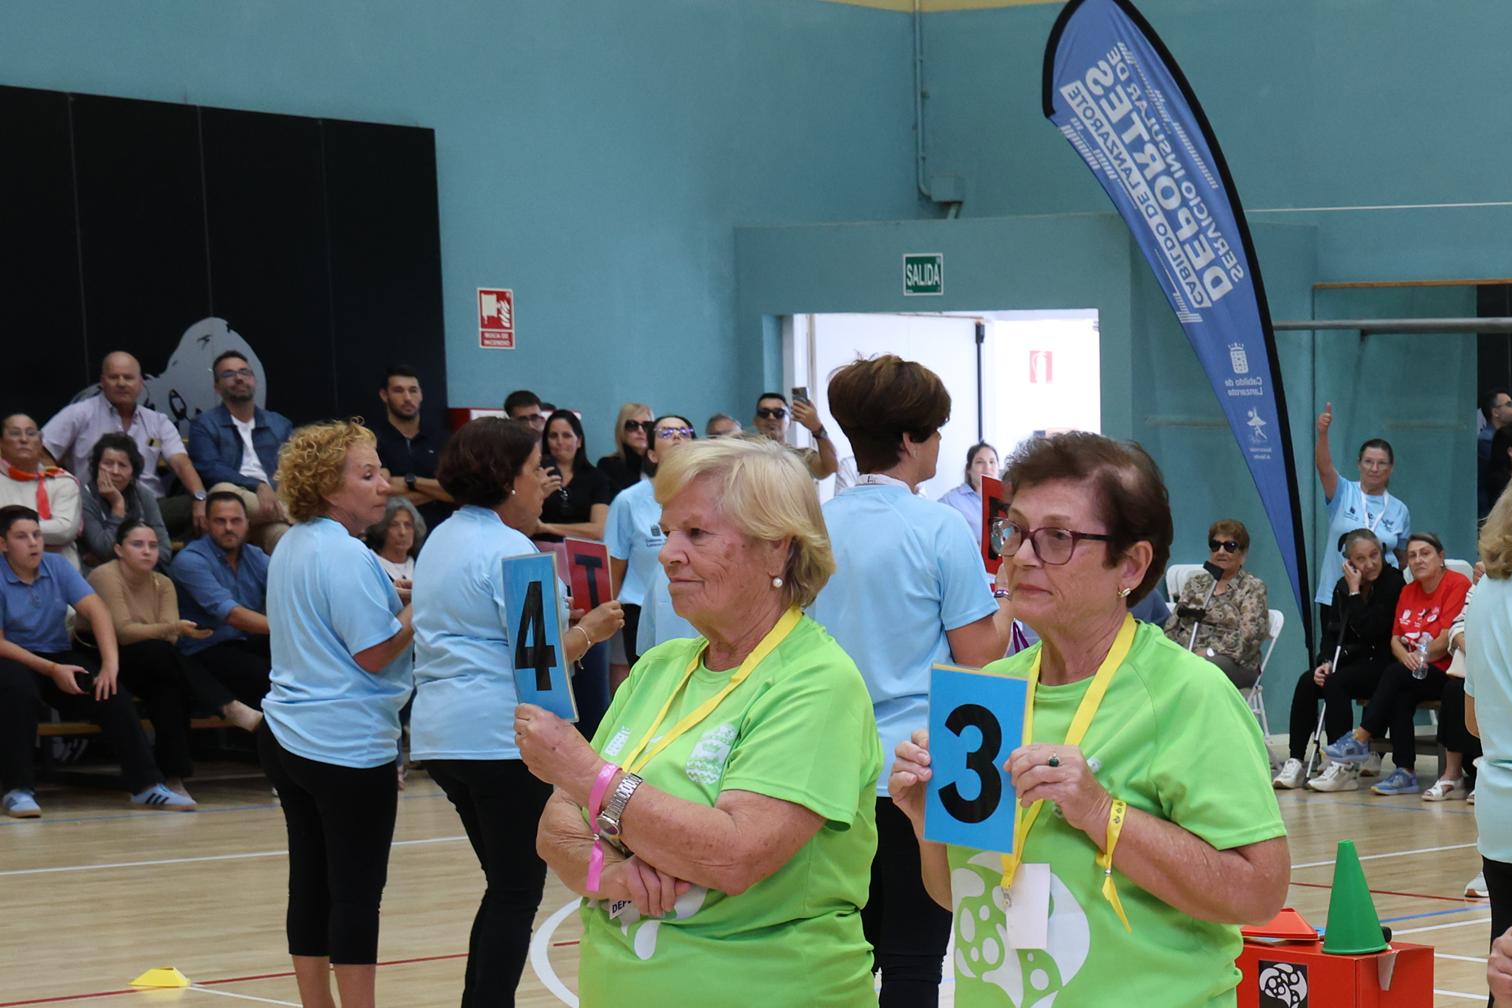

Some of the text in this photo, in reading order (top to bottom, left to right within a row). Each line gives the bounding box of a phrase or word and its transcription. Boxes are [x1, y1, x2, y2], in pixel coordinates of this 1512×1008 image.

[906, 263, 941, 286] SALIDA
[515, 580, 557, 691] 4
[938, 703, 1002, 824] 3
